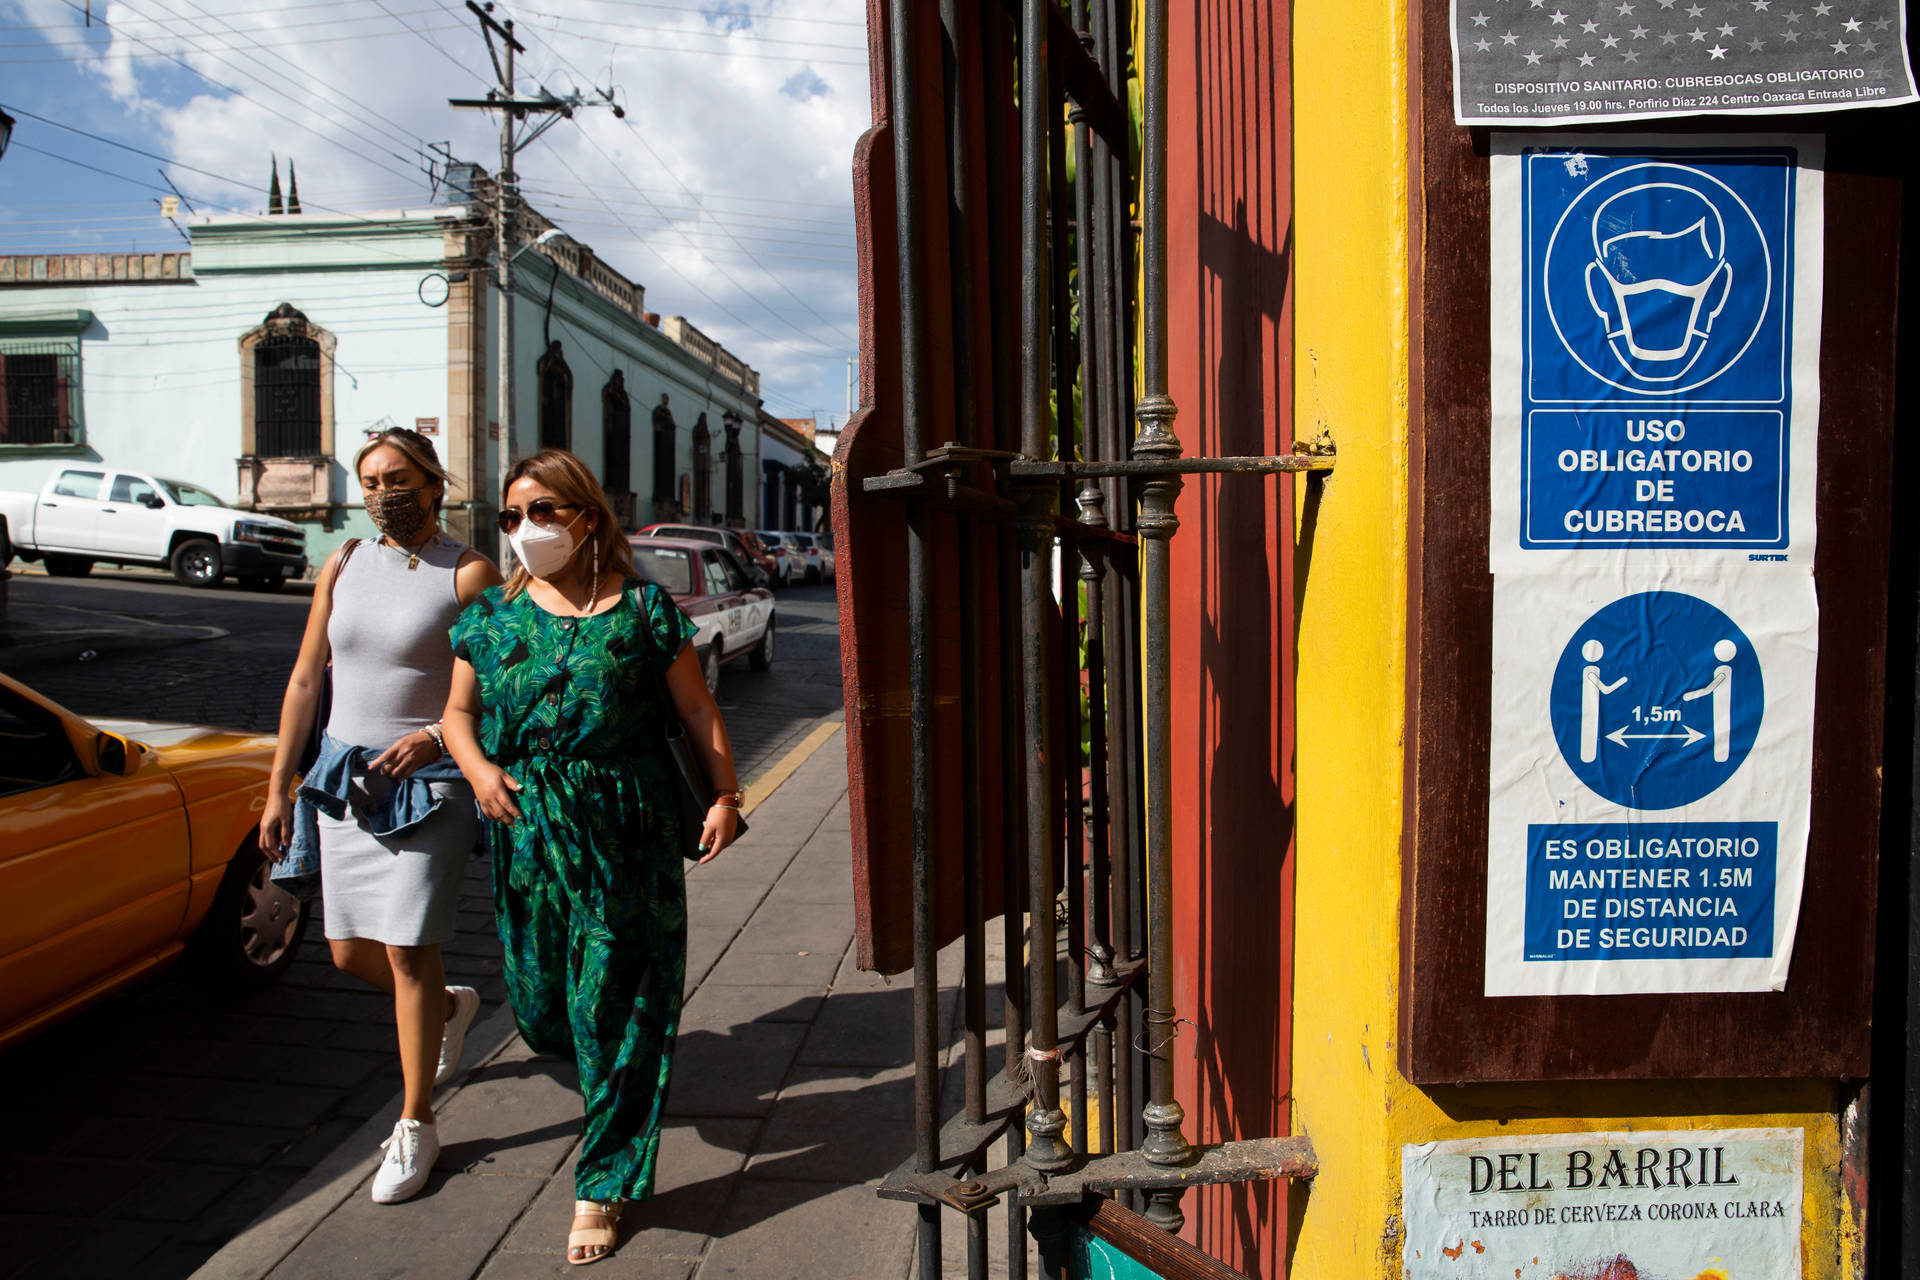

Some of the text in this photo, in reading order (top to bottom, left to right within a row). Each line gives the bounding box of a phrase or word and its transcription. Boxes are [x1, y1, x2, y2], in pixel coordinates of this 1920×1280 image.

[1495, 68, 1865, 94] DISPOSITIVO SANITARIO: CUBREBOCAS OBLIGATORIO
[1478, 85, 1887, 113] Todos los Jueves 19.00 hrs. Porfirio Díaz 224 Centro Oaxaca Entrada Libre
[1626, 420, 1686, 442] USO
[1558, 450, 1753, 472] OBLIGATORIO
[1636, 480, 1674, 502] DE
[1563, 510, 1746, 533] CUBREBOCA
[1631, 705, 1682, 725] 1,5m
[1545, 837, 1759, 860] ES OBLIGATORIO
[1549, 867, 1753, 890] MANTENER 1.5M
[1563, 897, 1738, 919] DE DISTANCIA
[1556, 926, 1748, 949] DE SEGURIDAD
[1468, 1146, 1740, 1195] DEL BARRIL
[1469, 1200, 1785, 1228] TARRO DE CERVEZA CORONA CLARA
